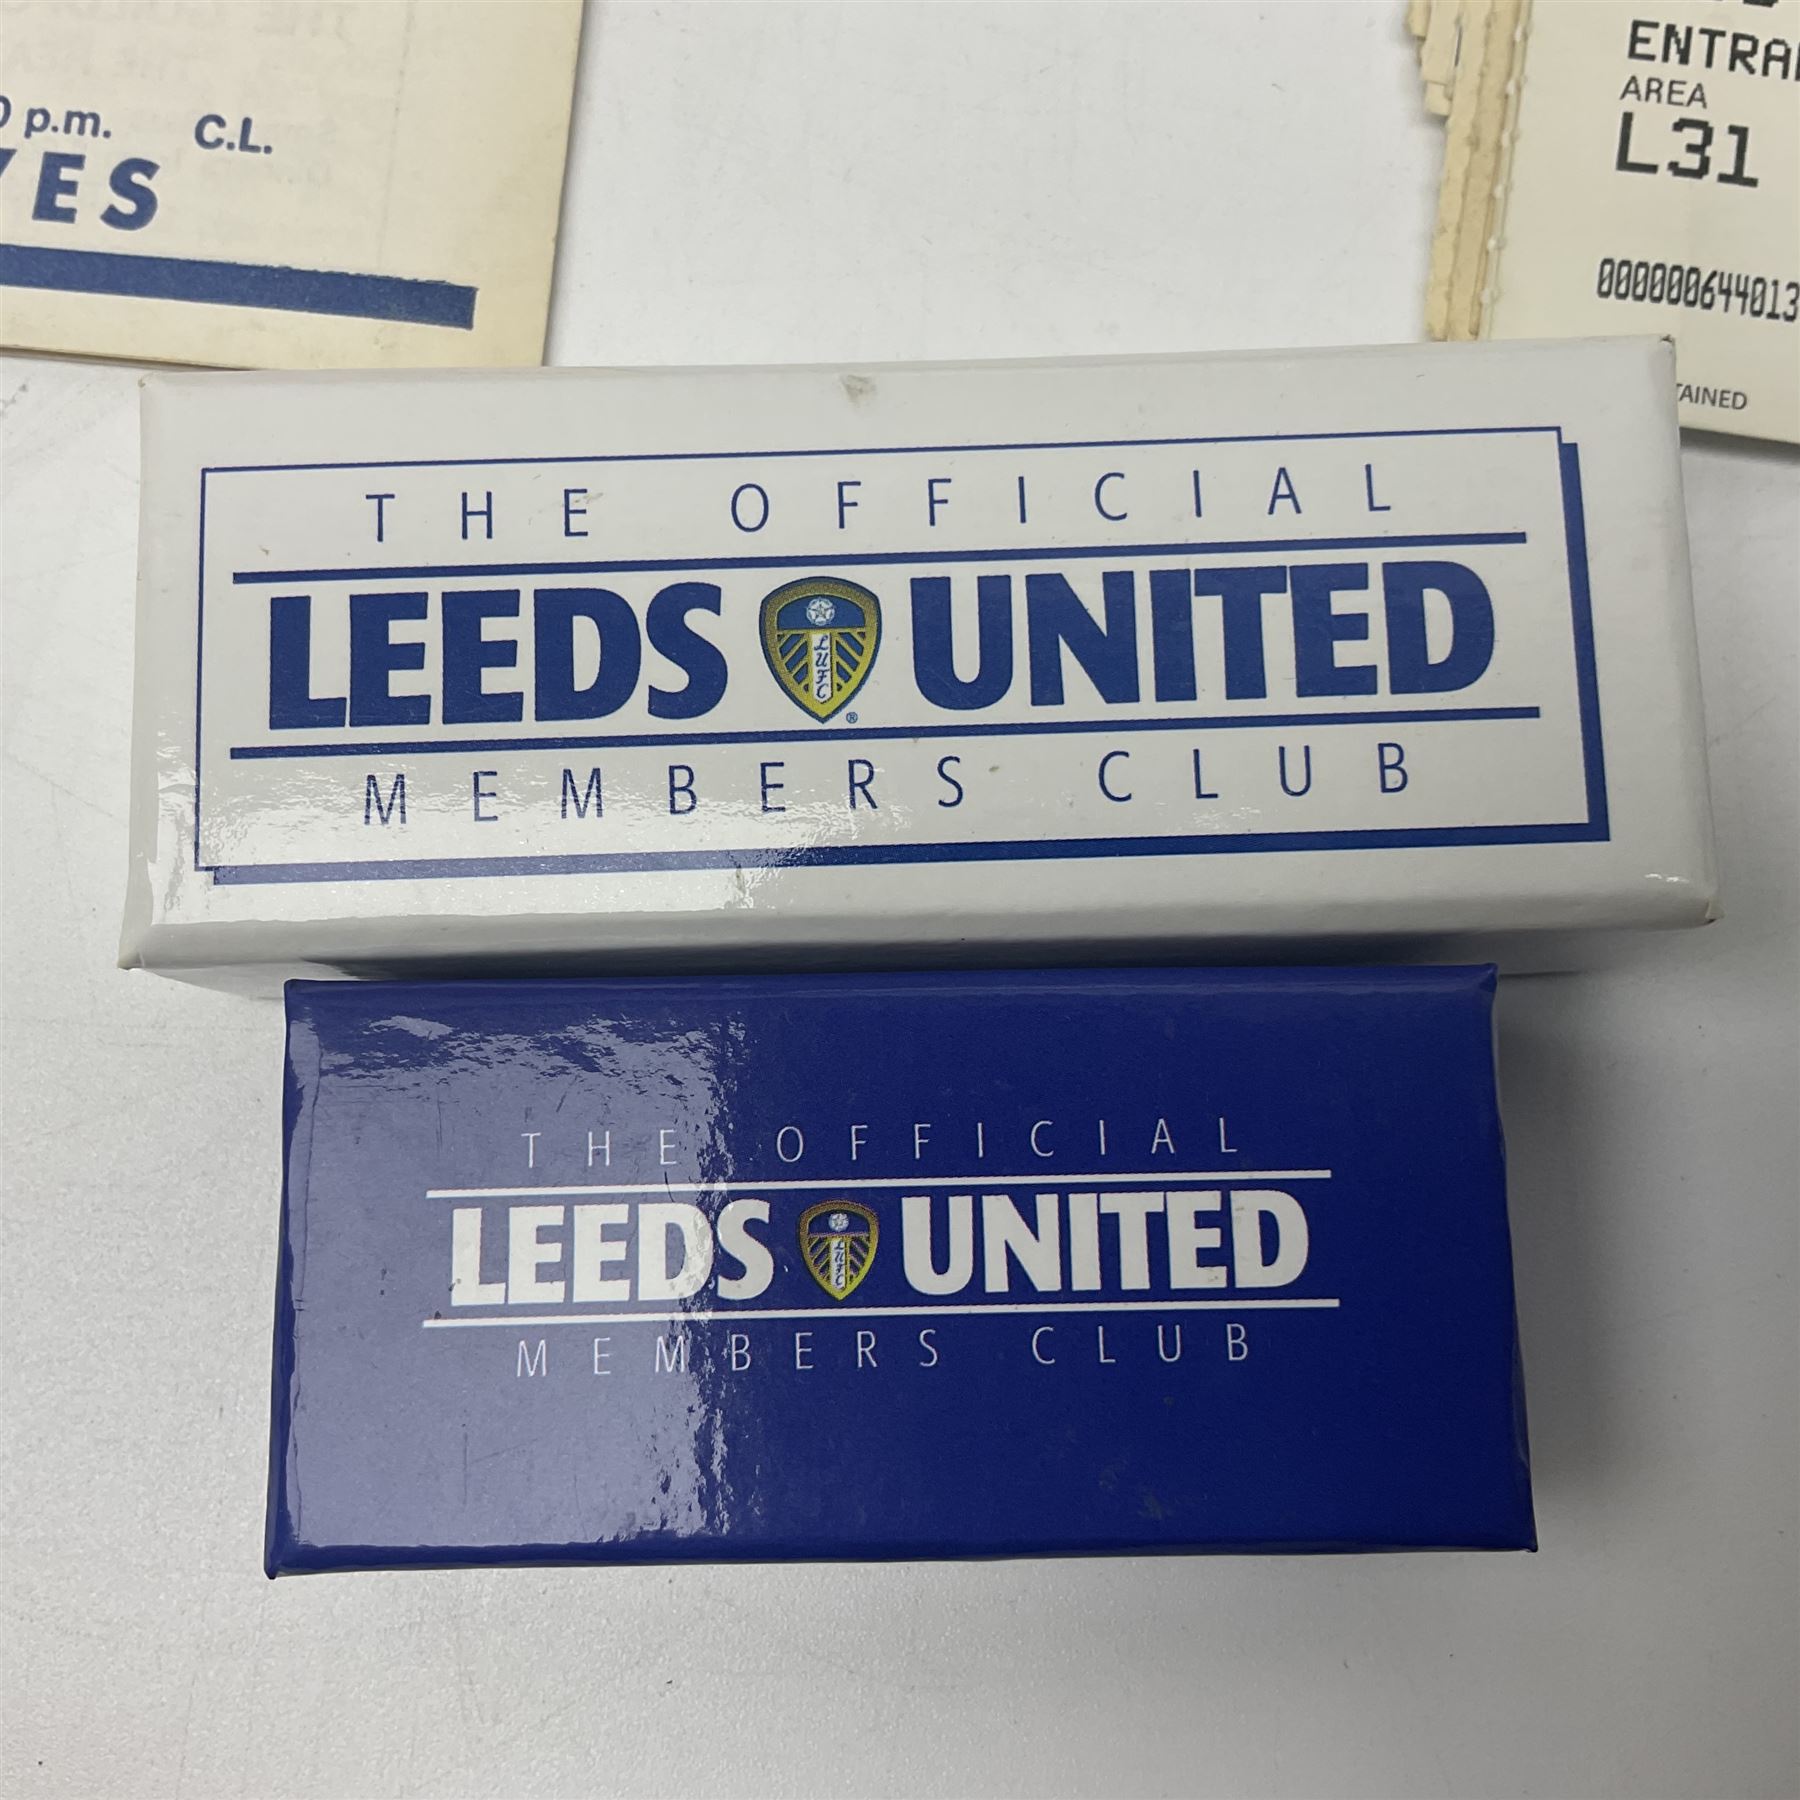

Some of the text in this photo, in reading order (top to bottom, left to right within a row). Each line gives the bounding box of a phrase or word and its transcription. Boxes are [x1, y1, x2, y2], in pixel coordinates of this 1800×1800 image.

[1628, 19, 1800, 81] ENTRA
[1620, 75, 1707, 109] AREA
[24, 107, 111, 139] p.m.
[194, 114, 273, 154] C.L.
[1616, 112, 1759, 188] L31
[365, 463, 1391, 542] THE OFFICIAL
[269, 561, 1495, 730] LEEDS UNITED
[364, 742, 1408, 825] MEMBERS CLUB
[521, 1117, 1238, 1168] THE OFFICIAL
[451, 1190, 1309, 1306] LEEDS UNITED
[517, 1322, 1249, 1377] MEMBERS CLUB
